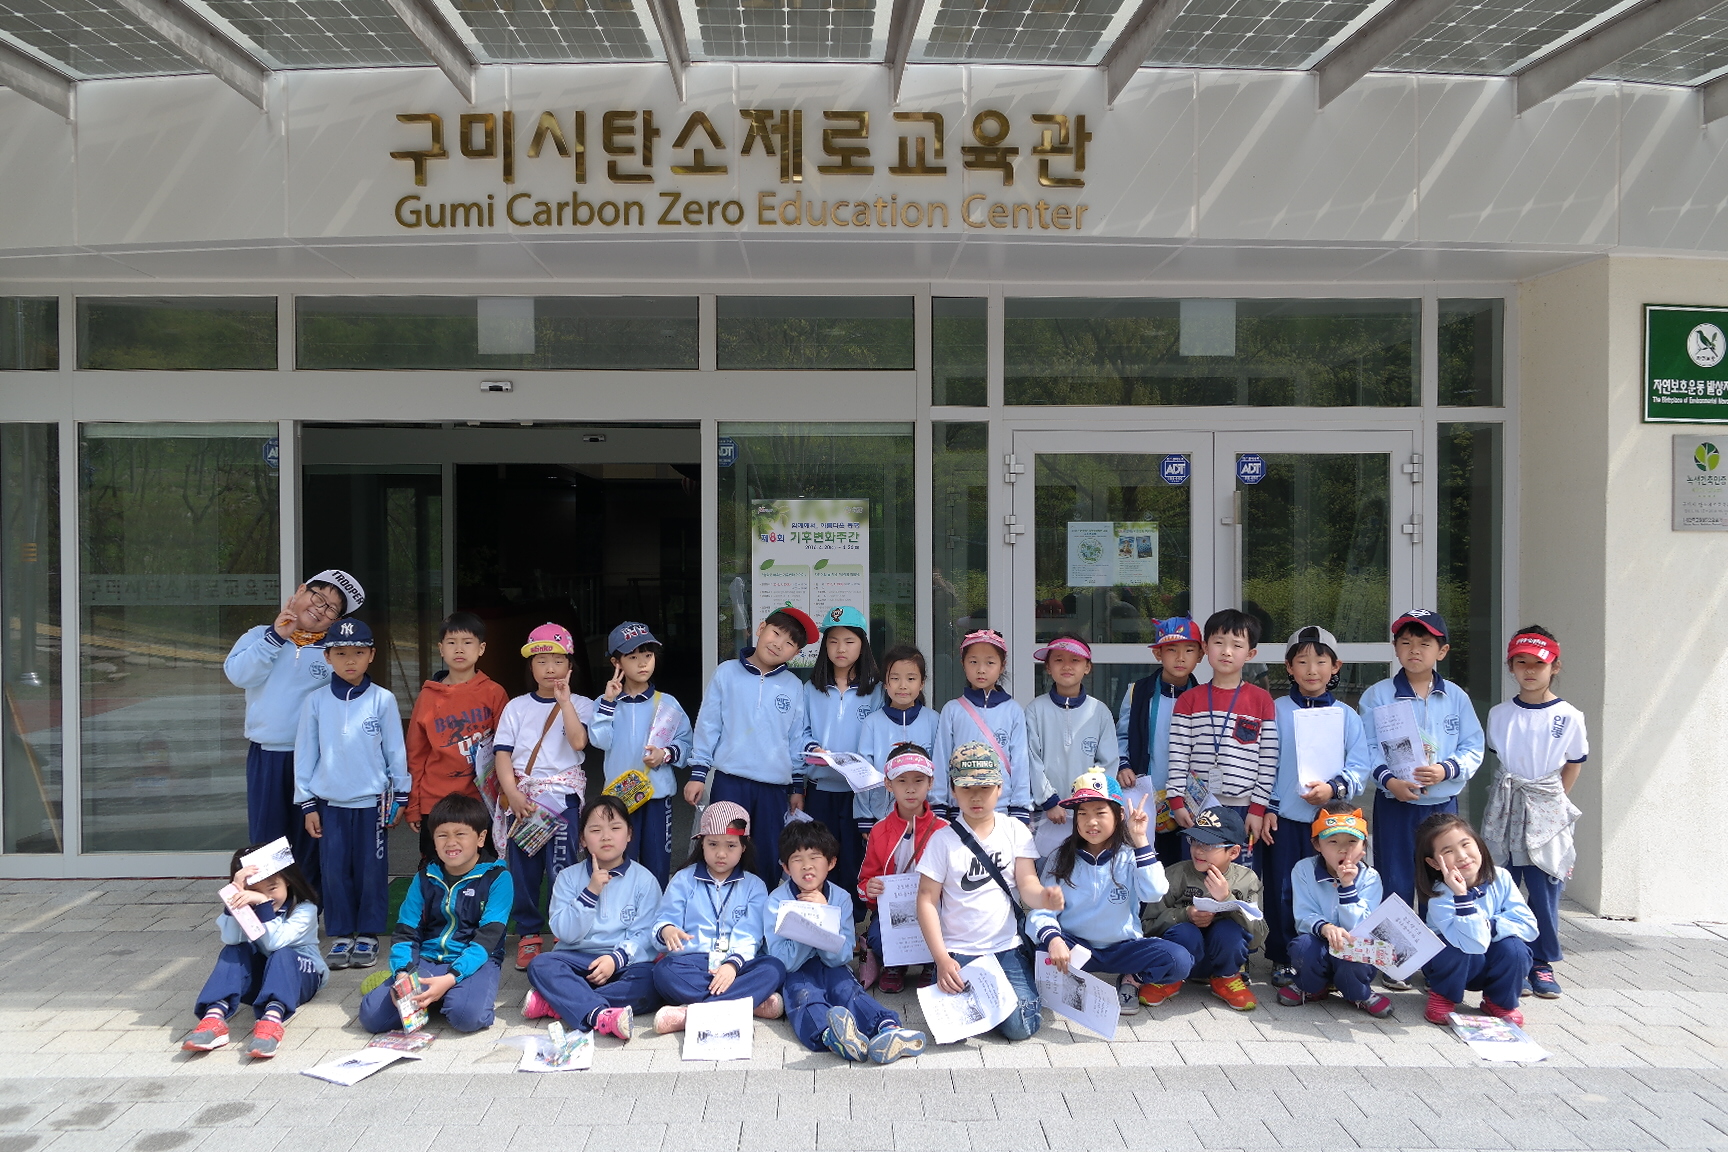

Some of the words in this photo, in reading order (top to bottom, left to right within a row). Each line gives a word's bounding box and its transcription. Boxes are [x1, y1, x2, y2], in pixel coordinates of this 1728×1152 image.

[390, 110, 1093, 188] 구미시탄소제로교육관
[394, 193, 495, 228] Gumi
[506, 191, 645, 227] Carbon
[657, 192, 745, 227] Zero
[757, 191, 949, 228] Education
[961, 193, 1090, 229] Center
[1653, 379, 1705, 396] 자연보호운동
[718, 446, 734, 457] DT
[1166, 463, 1186, 475] ADT
[1240, 462, 1262, 474] ADT
[761, 531, 785, 543] 제8회
[790, 531, 860, 544] 기후변화주간
[434, 706, 493, 734] BOARD
[961, 761, 994, 769] NOTHING
[968, 851, 1002, 877] NE
